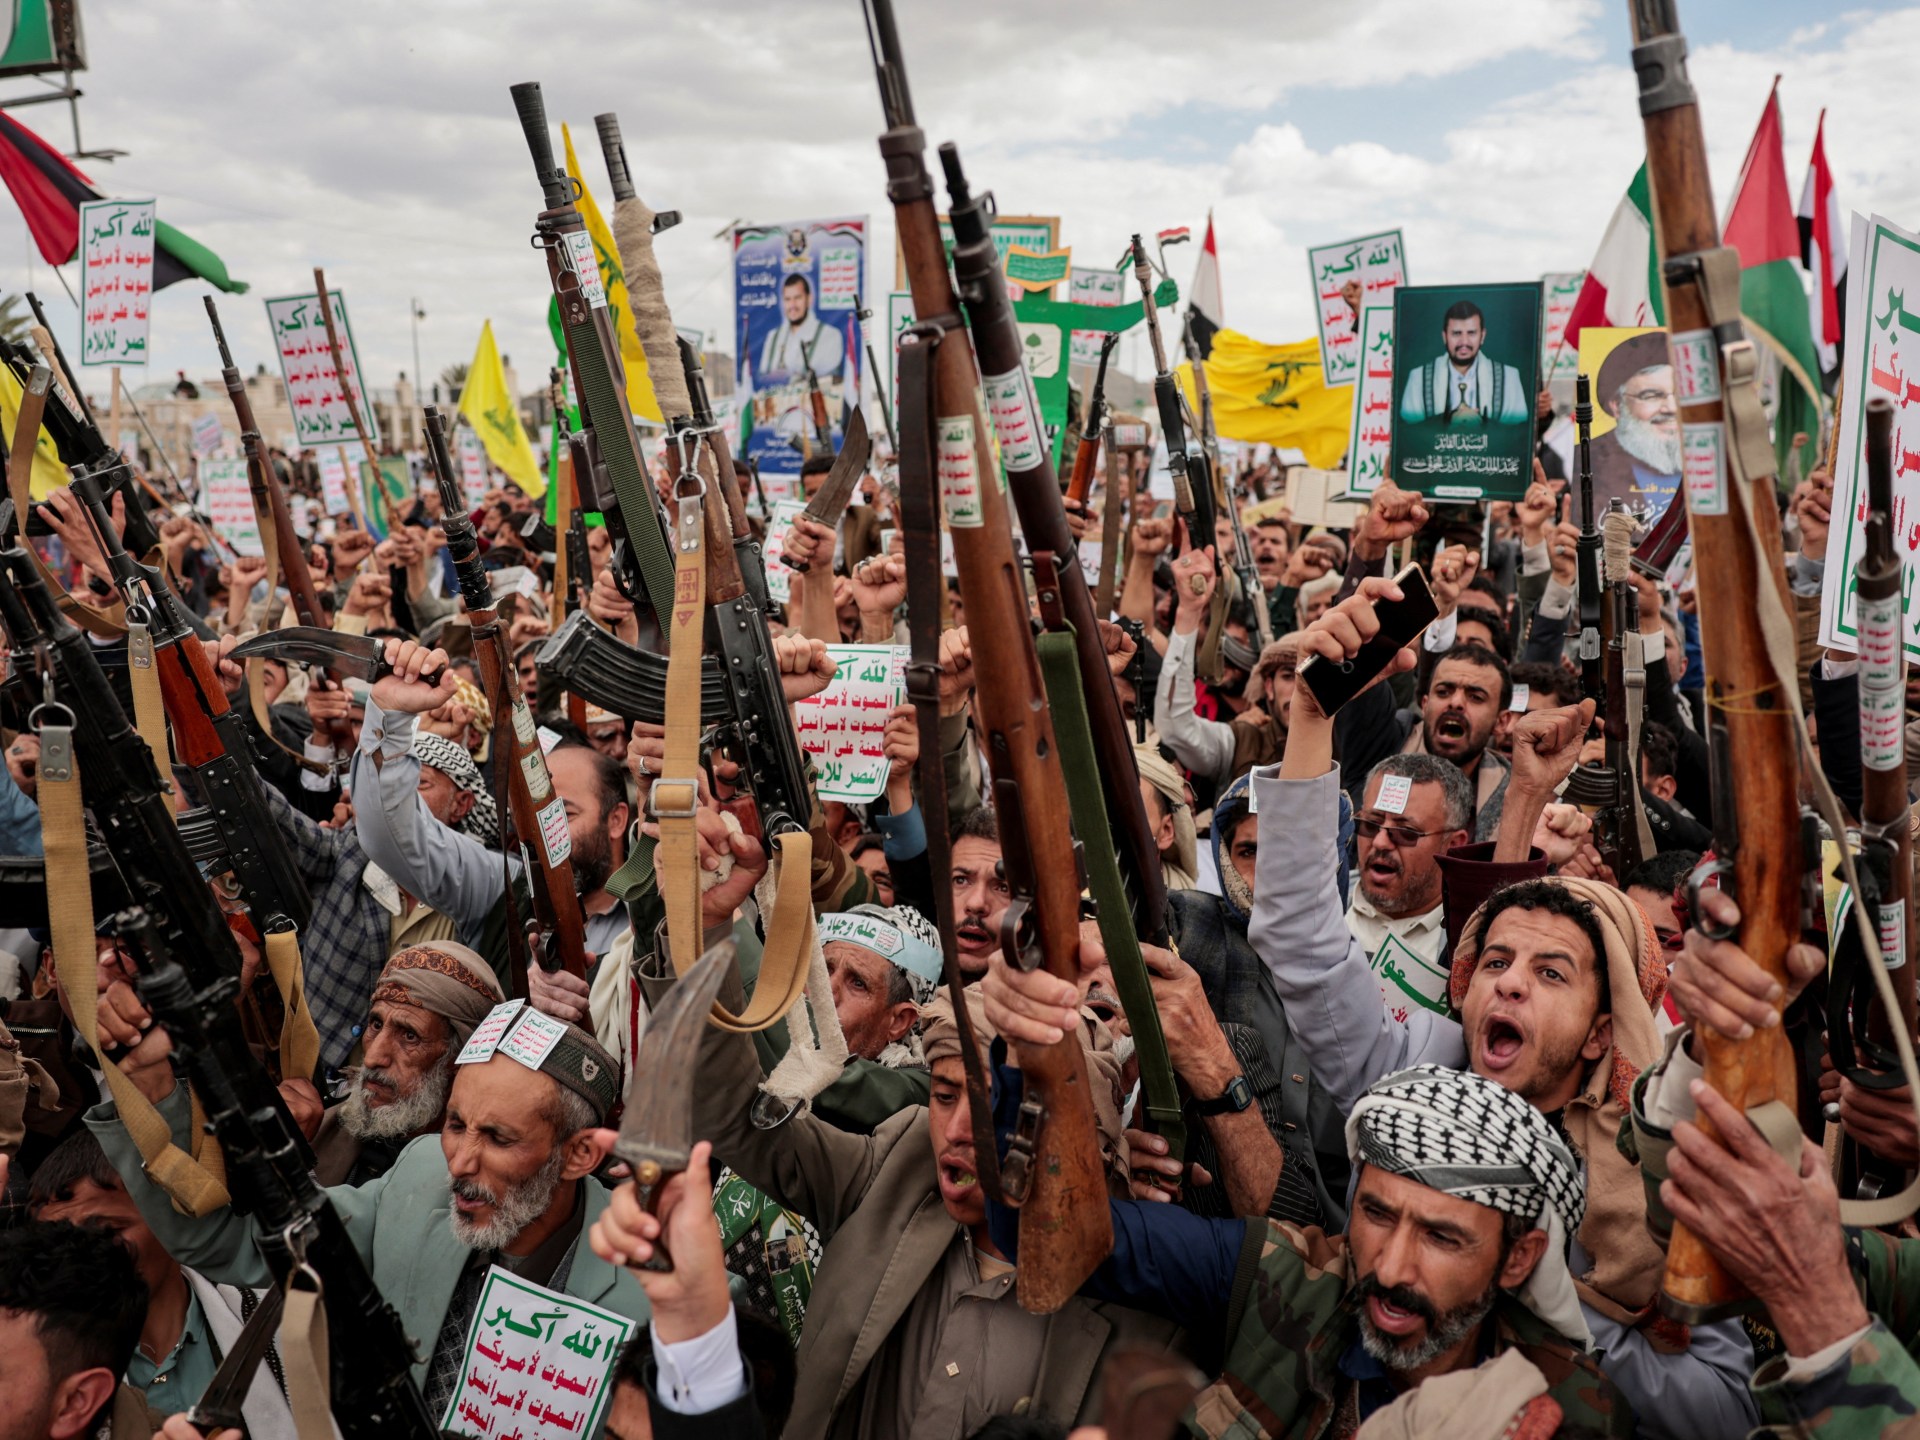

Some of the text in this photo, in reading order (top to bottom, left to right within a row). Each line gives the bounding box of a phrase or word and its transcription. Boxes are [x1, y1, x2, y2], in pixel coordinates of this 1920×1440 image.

[88, 207, 152, 247] لله أكبر
[1319, 241, 1399, 282] الله أكبر
[278, 301, 308, 339] أكبر
[1368, 328, 1393, 356] بر
[1330, 352, 1357, 376] سلام
[832, 654, 859, 681] أك
[859, 658, 888, 684] لله
[851, 693, 893, 712] الموت
[797, 715, 892, 736] لموت لإسرائيل
[802, 739, 830, 757] اليهو
[834, 739, 854, 758] على
[816, 761, 884, 789] النصر للإس
[483, 1305, 616, 1363] الله أكبر
[475, 1330, 598, 1399] الموت لأمريكا
[467, 1366, 585, 1434] الموت لإسرائيل
[458, 1397, 496, 1436] اليهود
